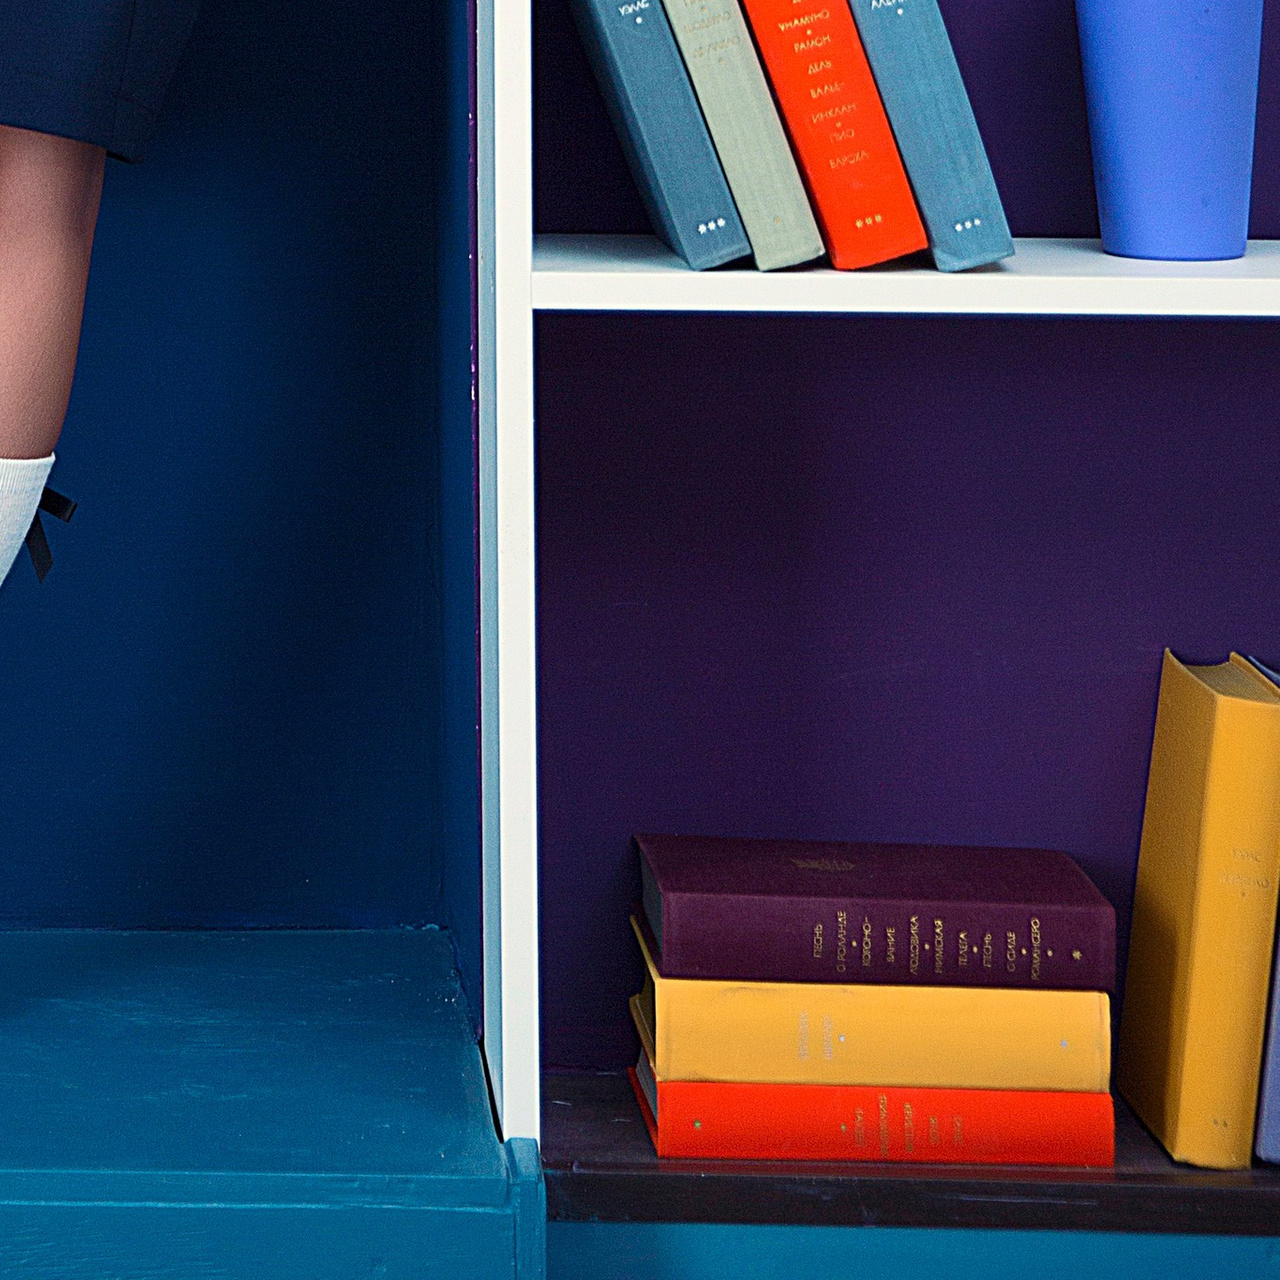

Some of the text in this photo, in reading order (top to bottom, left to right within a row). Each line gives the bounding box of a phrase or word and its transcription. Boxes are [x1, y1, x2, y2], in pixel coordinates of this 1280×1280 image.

[778, 10, 830, 31] УНАМУНО
[794, 35, 830, 53] РАМОН
[807, 60, 832, 74] ДЕЛЬ
[810, 82, 845, 98] ВАЛЬЕ-
[812, 103, 856, 122] ИНКЛАН
[830, 128, 854, 143] ПИО
[814, 924, 822, 957] ПЕСНЬ
[837, 911, 846, 959] РОЛАНДЕ
[862, 916, 871, 966] КОРОНО-
[886, 926, 895, 962] ВАНИЕ
[910, 916, 918, 974] ЛЮДОВИКА
[935, 919, 943, 973] НИМСКАЯ
[959, 931, 968, 966] ТЕЛЕГА
[984, 933, 992, 968] ПЕСНЬ
[1007, 931, 1016, 961] СИДЕ
[1031, 917, 1040, 979] РОМАНСЕРО
